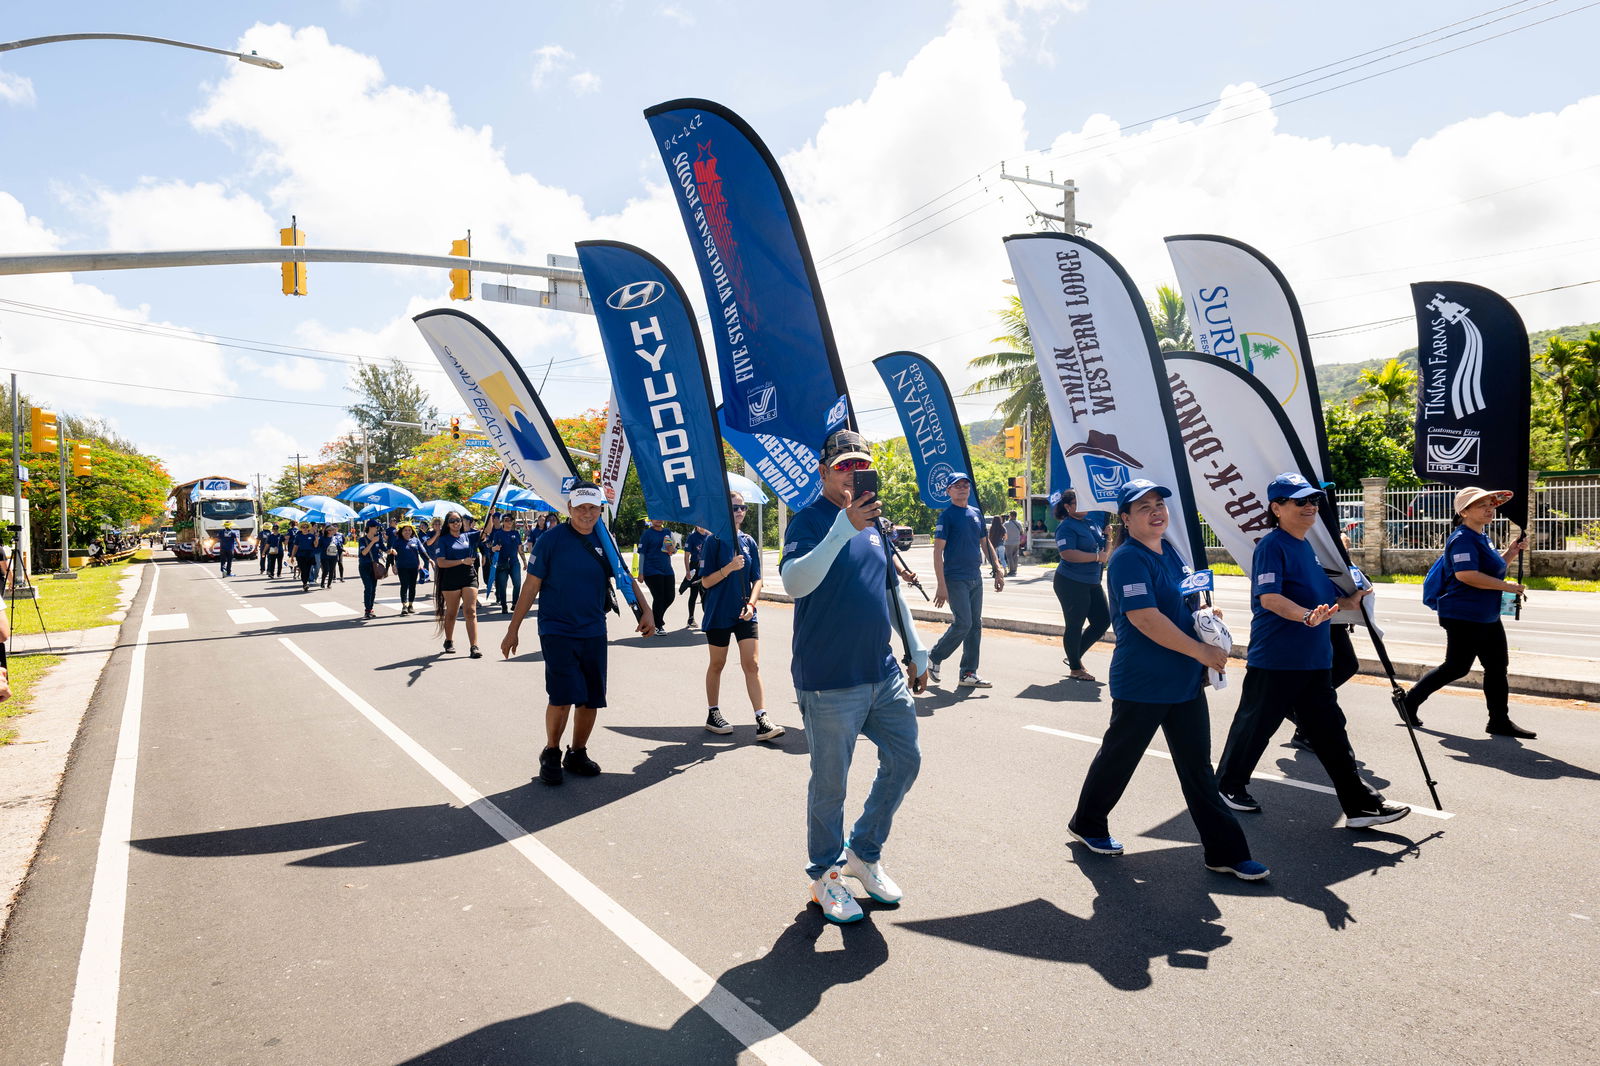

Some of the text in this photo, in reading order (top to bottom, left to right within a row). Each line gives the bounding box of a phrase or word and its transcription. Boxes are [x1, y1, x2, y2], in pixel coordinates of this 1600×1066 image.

[672, 151, 754, 385] FIVE STAR WHOLESALE FOODS
[1056, 250, 1116, 416] WESTERN LODGE
[1424, 317, 1448, 420] TINIAN FARMS
[443, 345, 482, 396] SANDY
[473, 396, 507, 447] BEACH
[630, 316, 696, 508] HYUNDAI
[891, 369, 938, 465] TINIAN
[909, 363, 947, 455] GARDEN B&B
[1053, 346, 1088, 423] TINIAN
[603, 439, 619, 481] Tinian
[755, 433, 810, 488] CONFERE
[782, 437, 819, 474] CENT
[1427, 426, 1480, 437] Customers First
[1430, 463, 1477, 473] TRIPLE J
[755, 456, 800, 502] TINIAN
